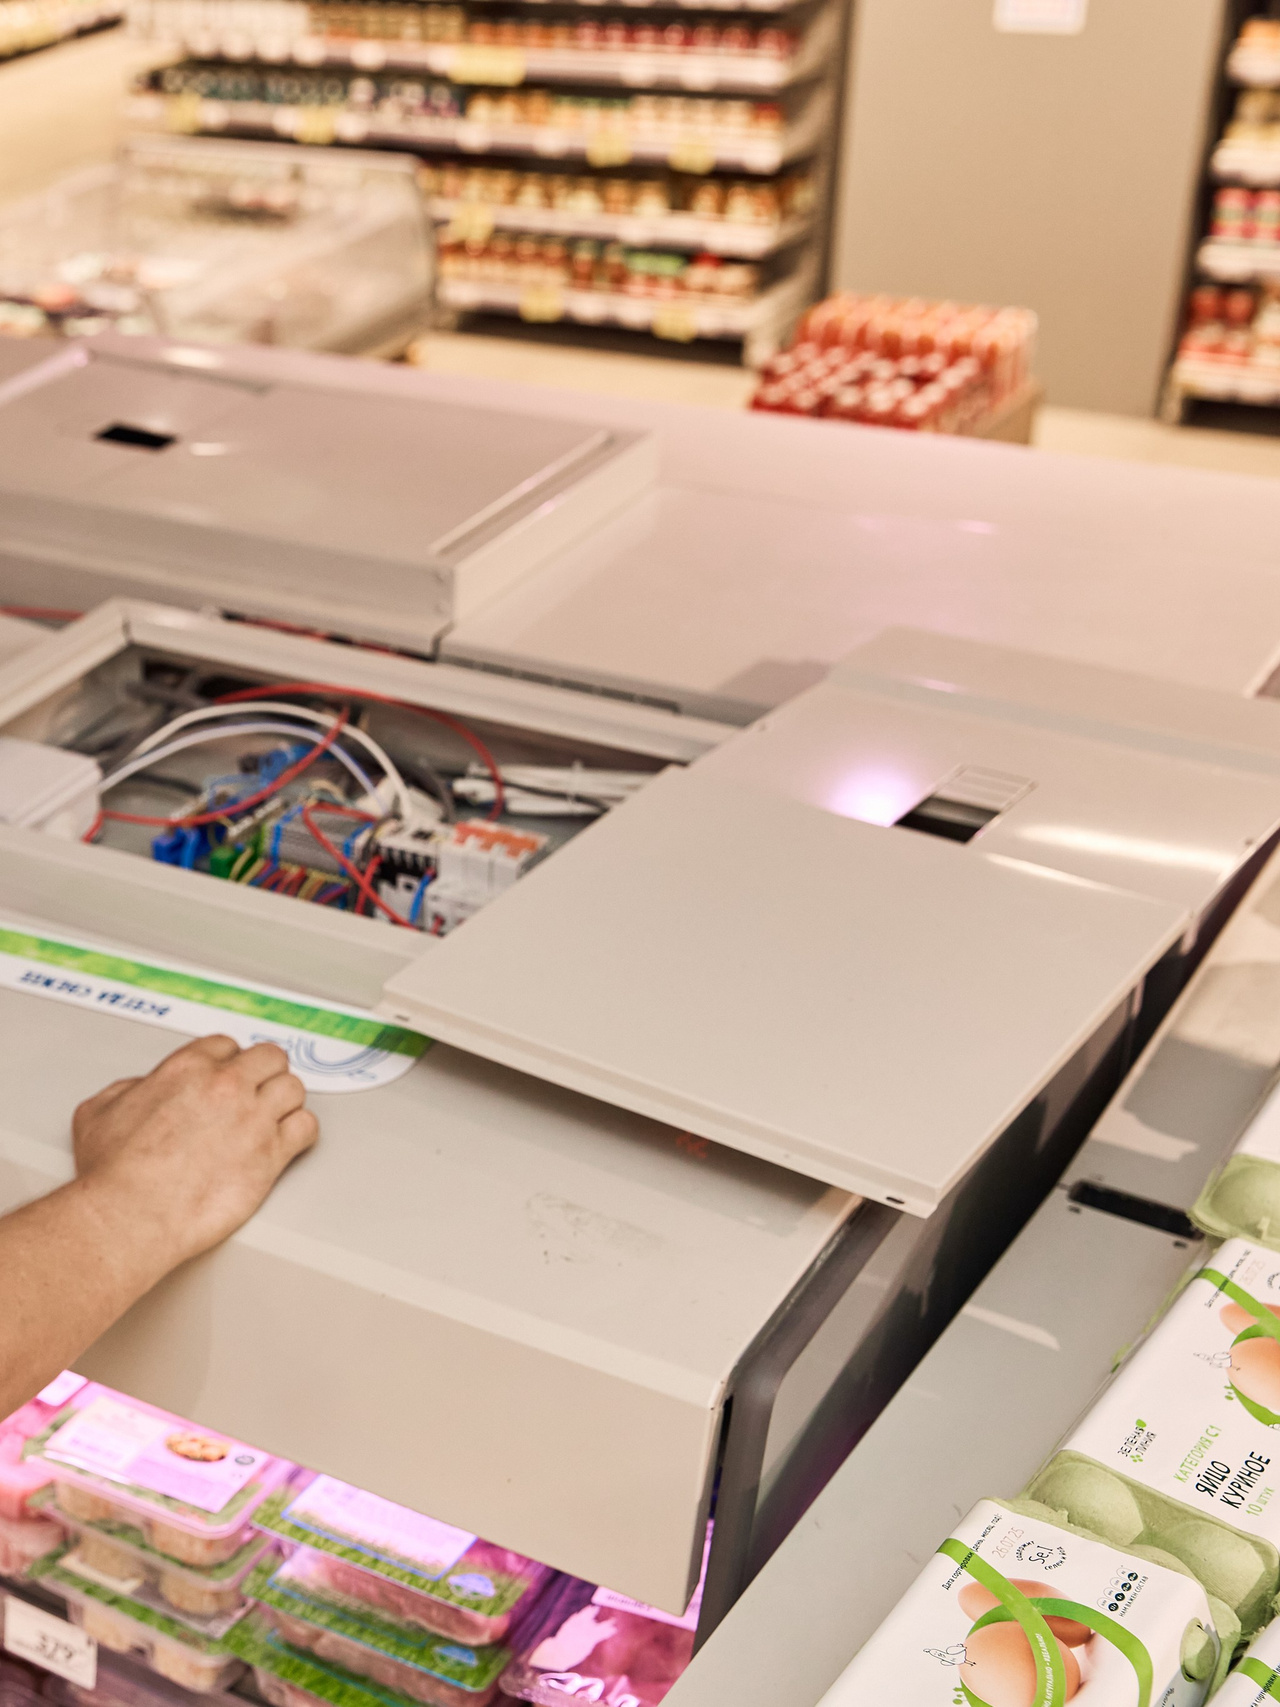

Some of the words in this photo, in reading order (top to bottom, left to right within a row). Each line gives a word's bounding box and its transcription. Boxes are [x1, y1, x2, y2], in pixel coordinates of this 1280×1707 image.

[1135, 1431, 1157, 1455] ЛИНИЯ
[1173, 1436, 1214, 1483] КАТЕГОРИЯ
[1195, 1460, 1231, 1498] ЯЙЦО
[1219, 1451, 1271, 1509] КУРИНОЕ
[1245, 1503, 1263, 1517] 10
